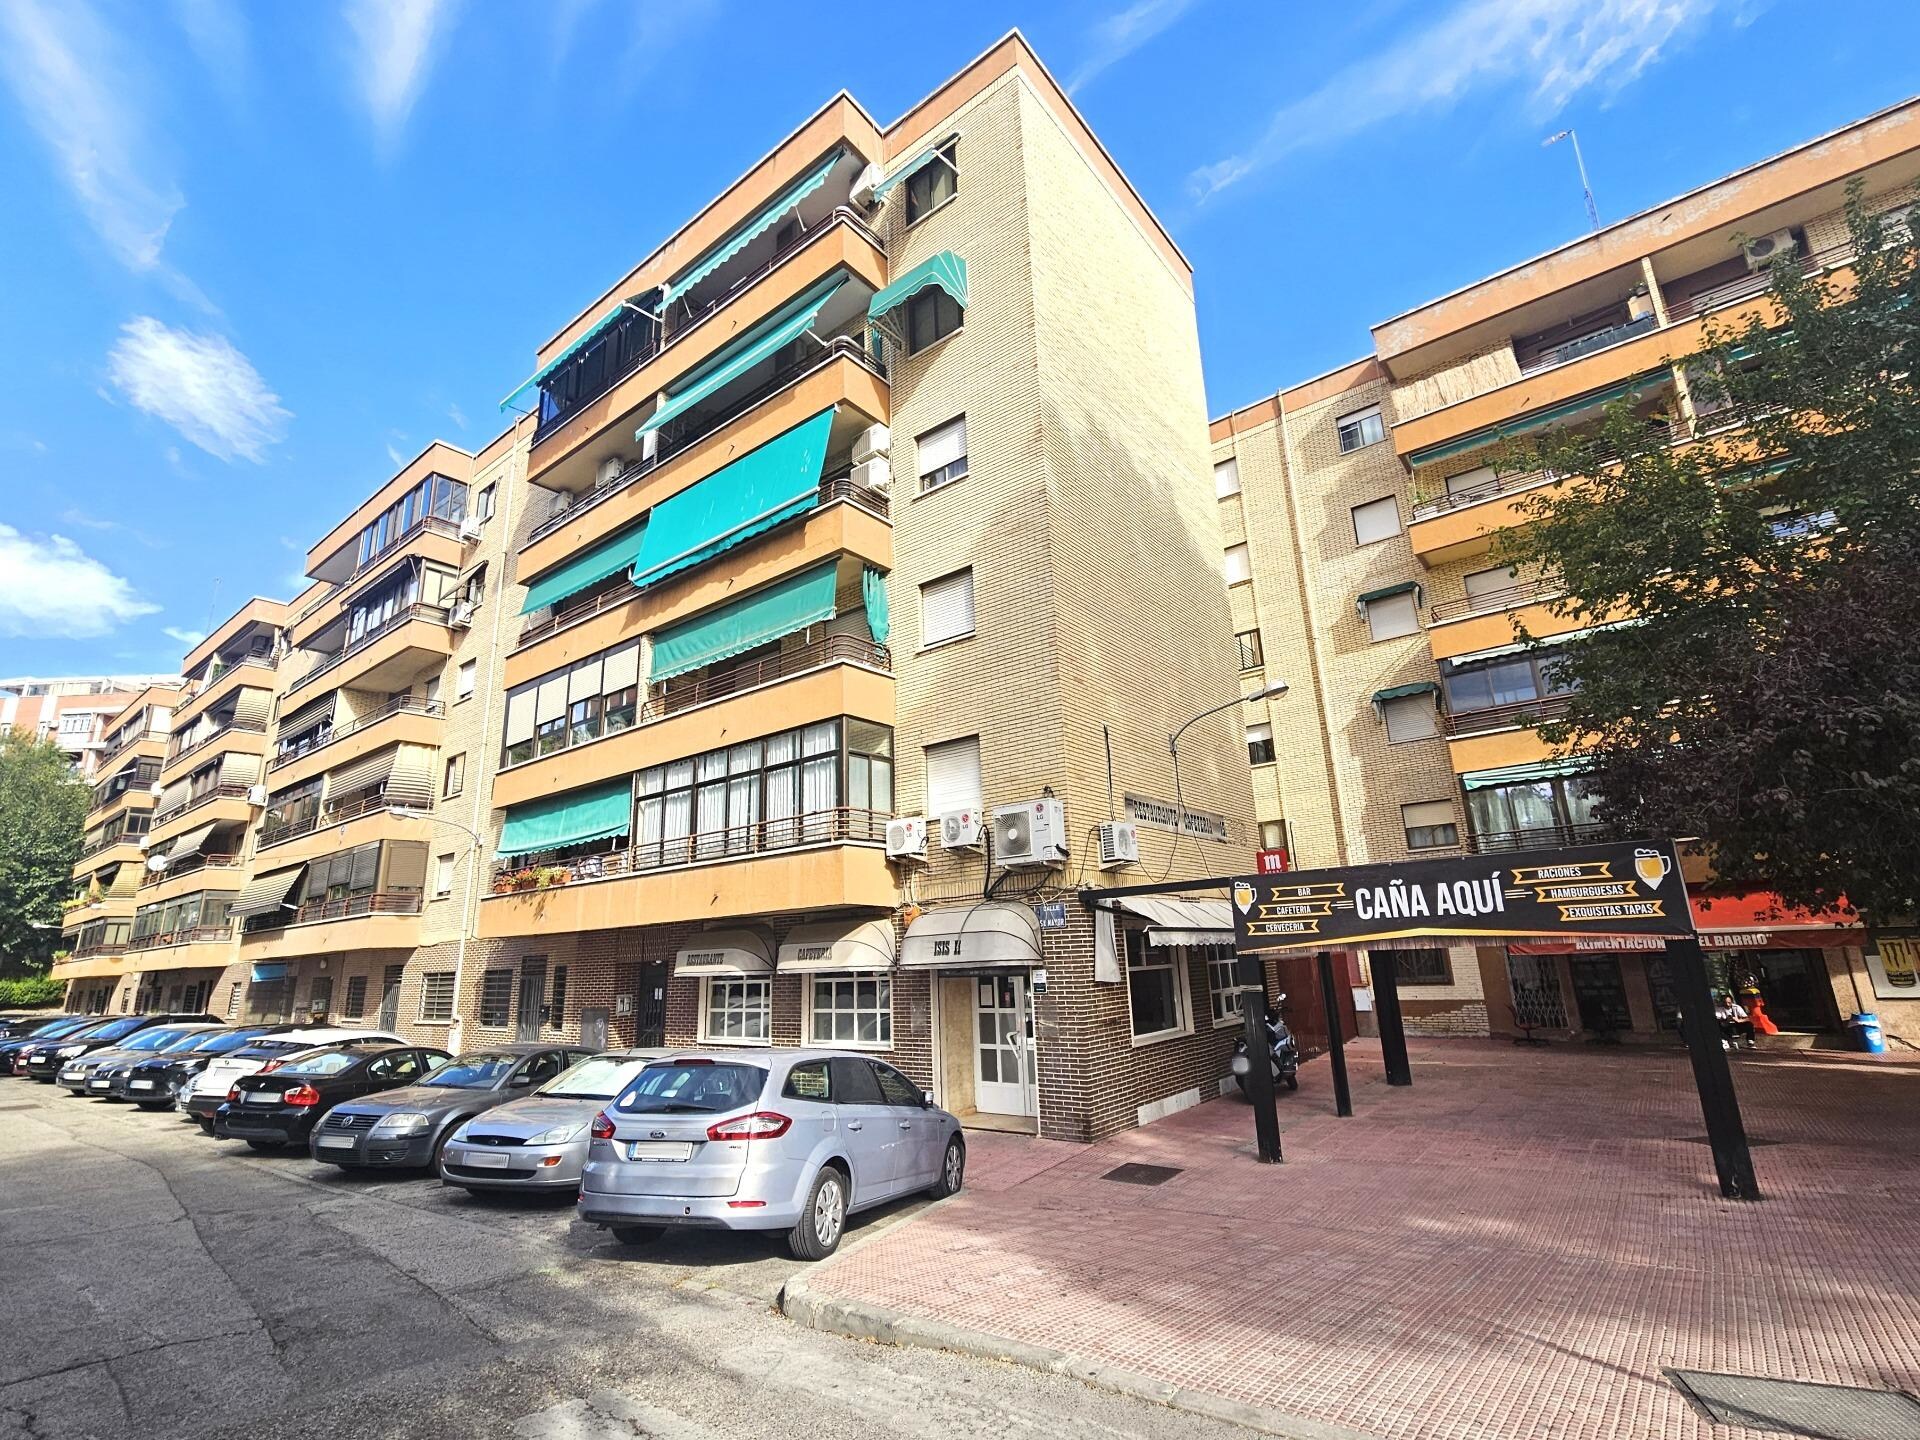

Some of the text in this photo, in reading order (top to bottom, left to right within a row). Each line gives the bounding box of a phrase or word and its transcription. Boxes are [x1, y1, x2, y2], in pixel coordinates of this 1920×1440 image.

[1133, 800, 1178, 827] RESTAURANTE
[1537, 866, 1582, 879] RACIONES
[1297, 887, 1312, 897] BAR
[1355, 871, 1505, 920] CAÑA AQUÍ
[1550, 884, 1625, 899] HAMBURGUESAS
[1276, 905, 1312, 915] CAFETERIA
[1568, 903, 1654, 918] EXQUISITAS TAPAS
[1047, 918, 1065, 927] MAYOR
[1265, 922, 1305, 932] CERVECERIA
[797, 947, 833, 961] CAFETERIA
[934, 940, 950, 957] ISIS
[686, 952, 725, 966] RESTAURANTE
